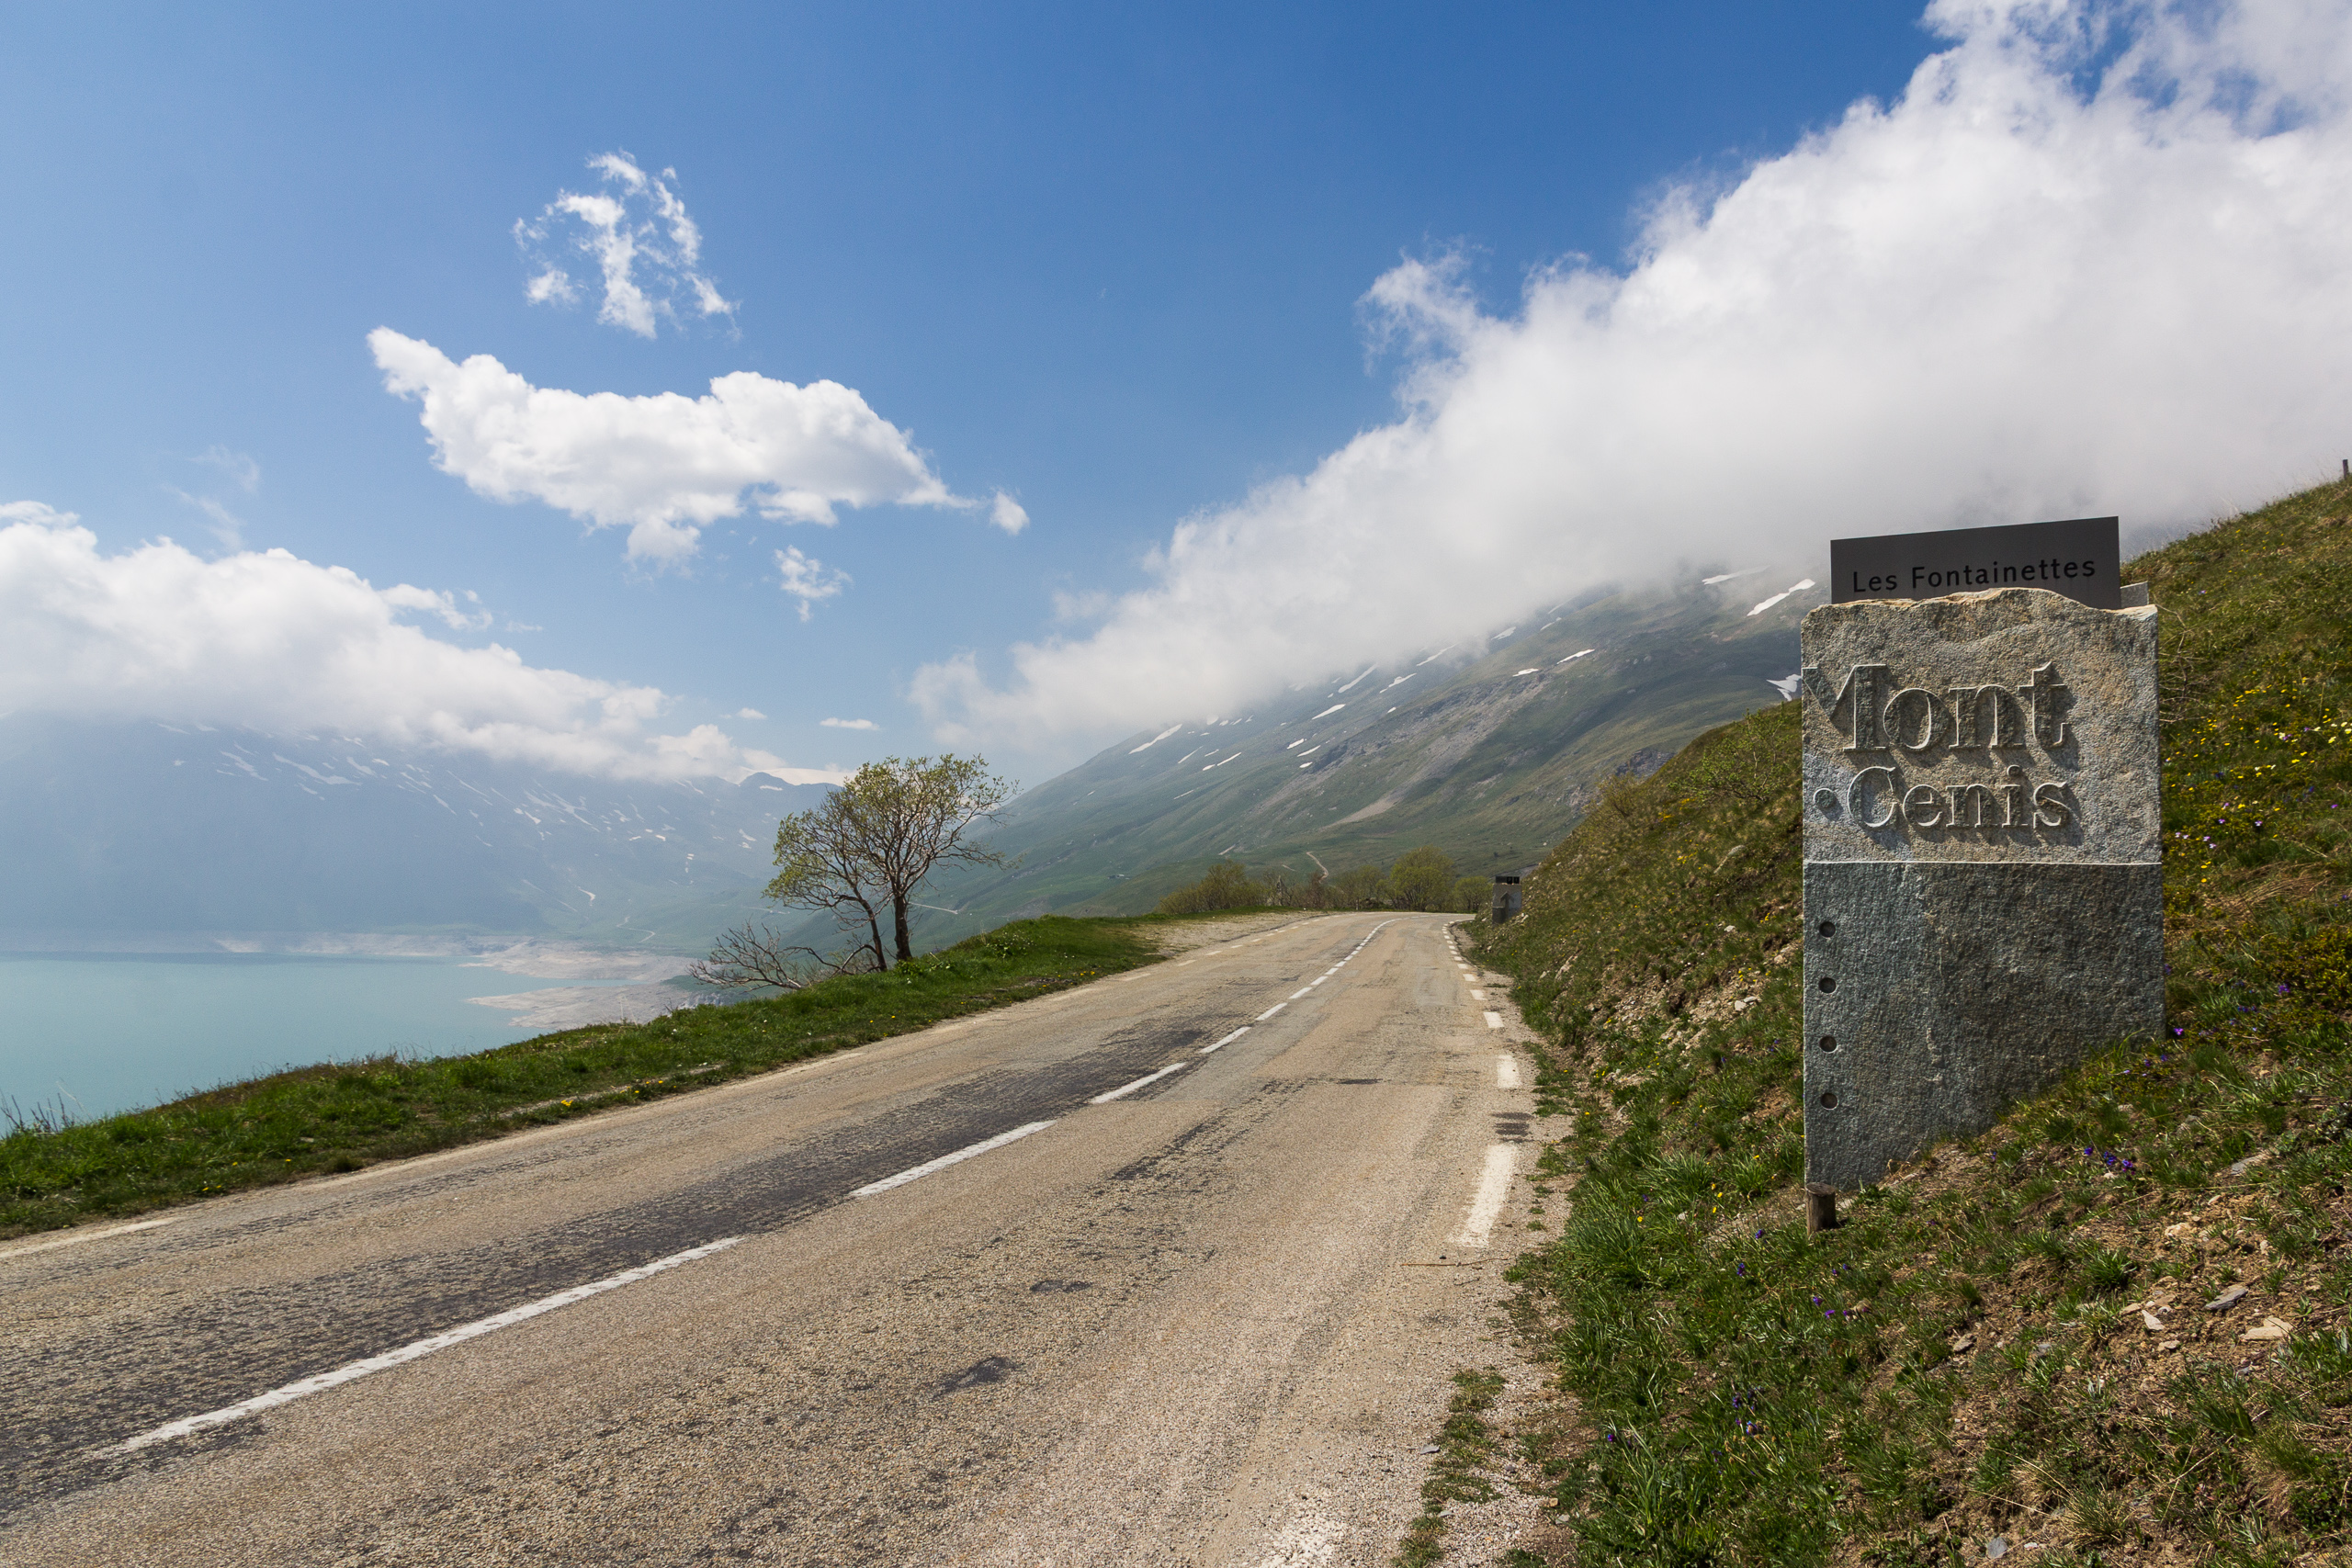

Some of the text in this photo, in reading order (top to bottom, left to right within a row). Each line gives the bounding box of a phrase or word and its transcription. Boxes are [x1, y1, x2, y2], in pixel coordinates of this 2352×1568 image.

[1853, 558, 2096, 592] Les Fontainettes
[1847, 765, 2070, 829] Cenis
